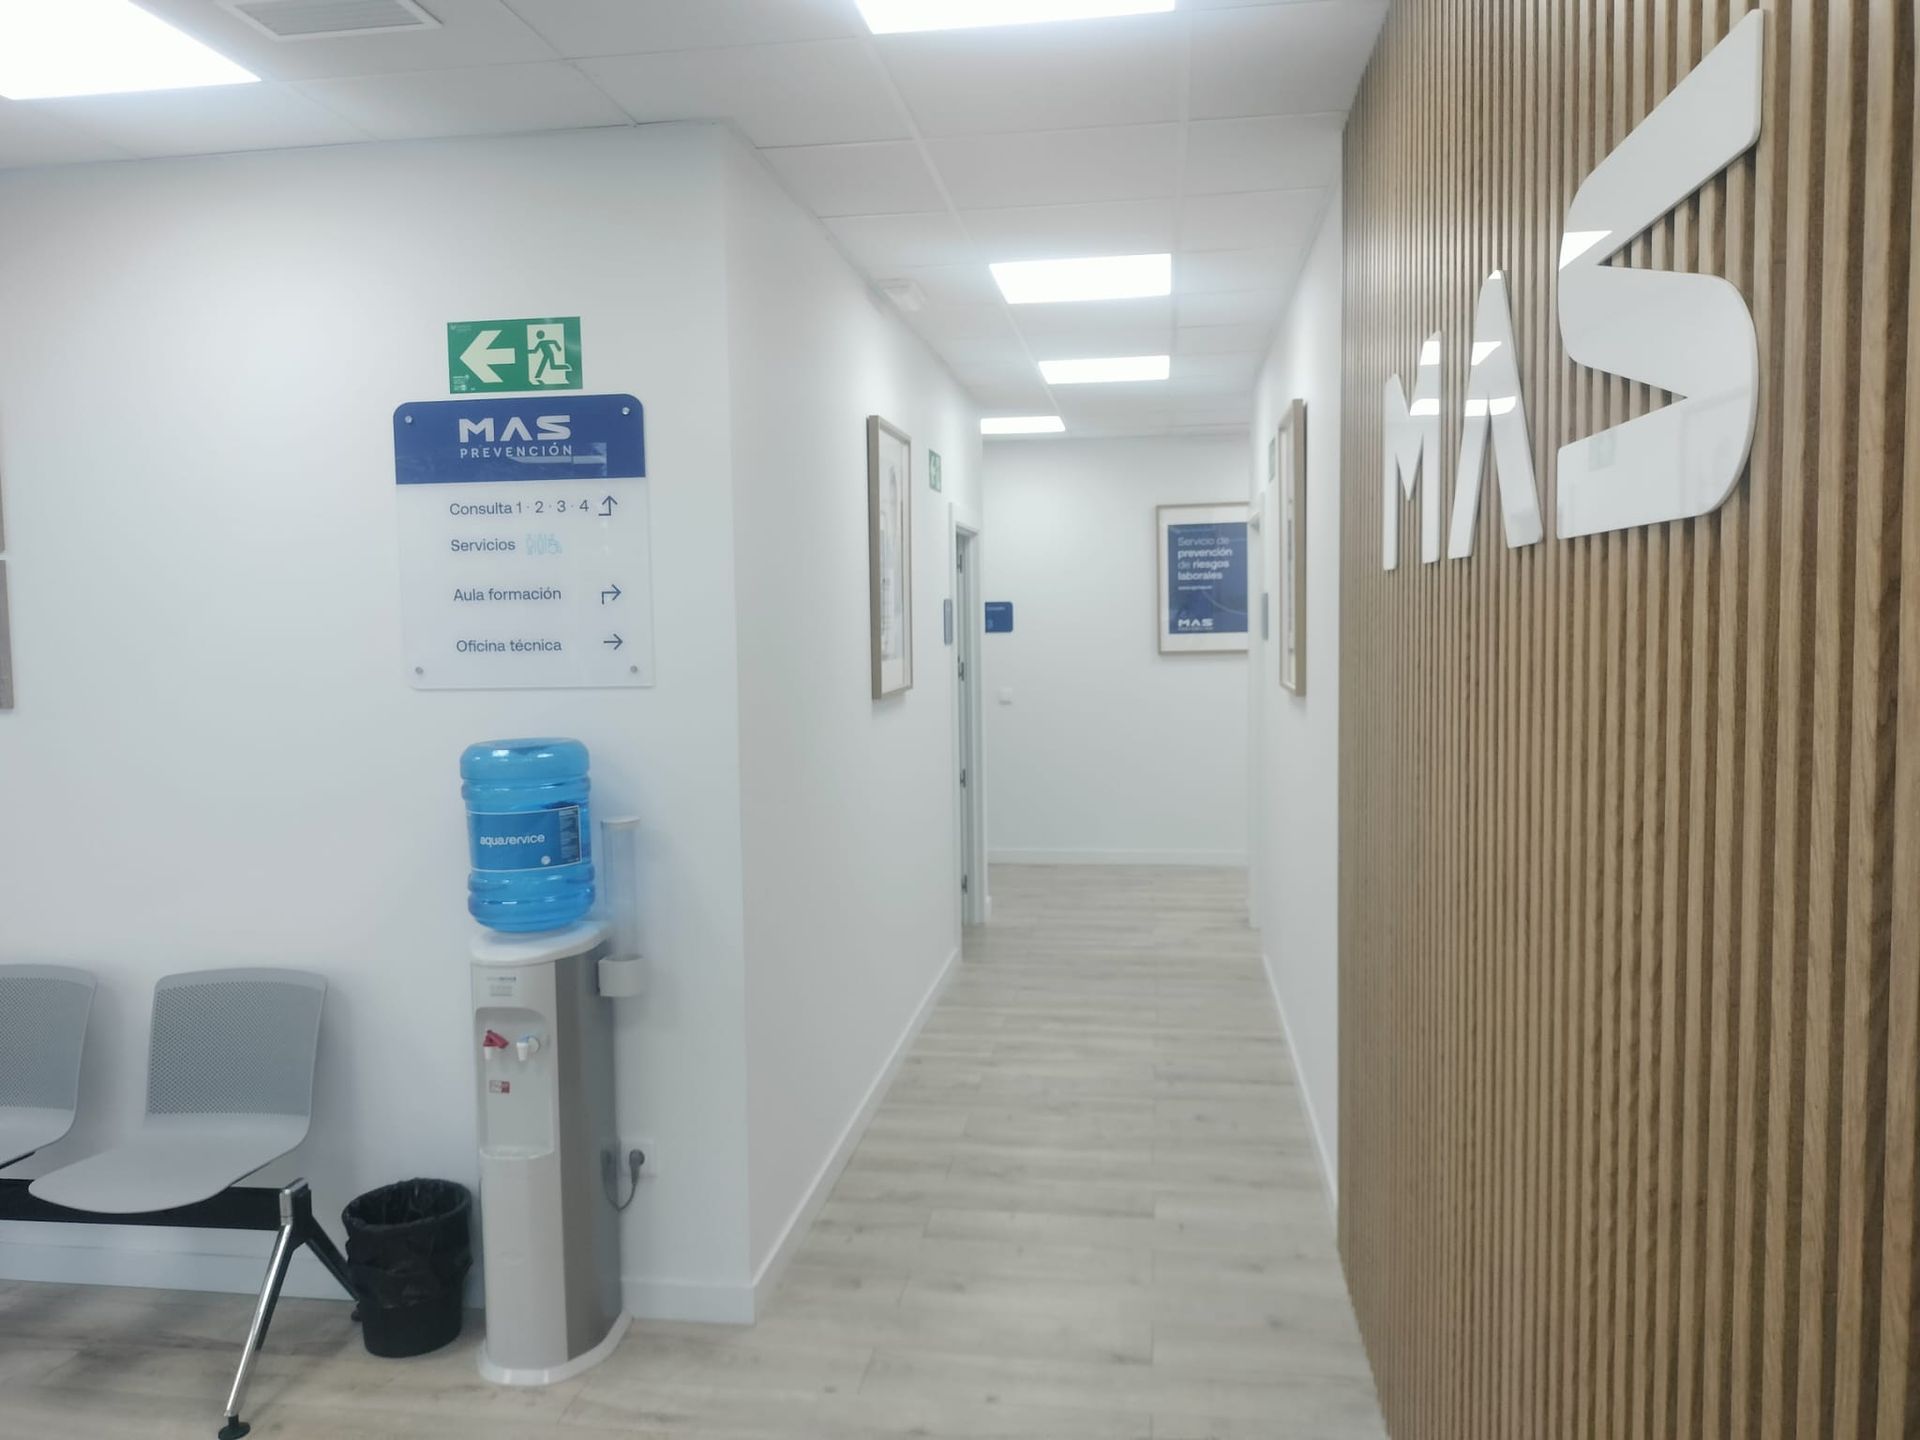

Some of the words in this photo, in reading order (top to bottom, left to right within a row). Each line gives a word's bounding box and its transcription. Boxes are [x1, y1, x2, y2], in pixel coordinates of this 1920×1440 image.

[1383, 8, 1764, 571] MAS
[458, 414, 572, 443] MAS
[459, 442, 573, 459] PREVENCIÓN
[449, 502, 513, 516] Consulta
[450, 538, 516, 552] Servicios
[1177, 537, 1215, 546] Servicio
[1217, 537, 1230, 545] de
[1178, 547, 1232, 559] prevención
[1192, 559, 1230, 570] riesgos
[1177, 571, 1223, 581] laborales
[453, 588, 485, 602] Aula
[488, 587, 562, 602] formación
[1178, 618, 1213, 627] MAS
[456, 639, 506, 653] Oficina
[509, 638, 562, 652] técnica
[480, 833, 546, 848] aquaservice
